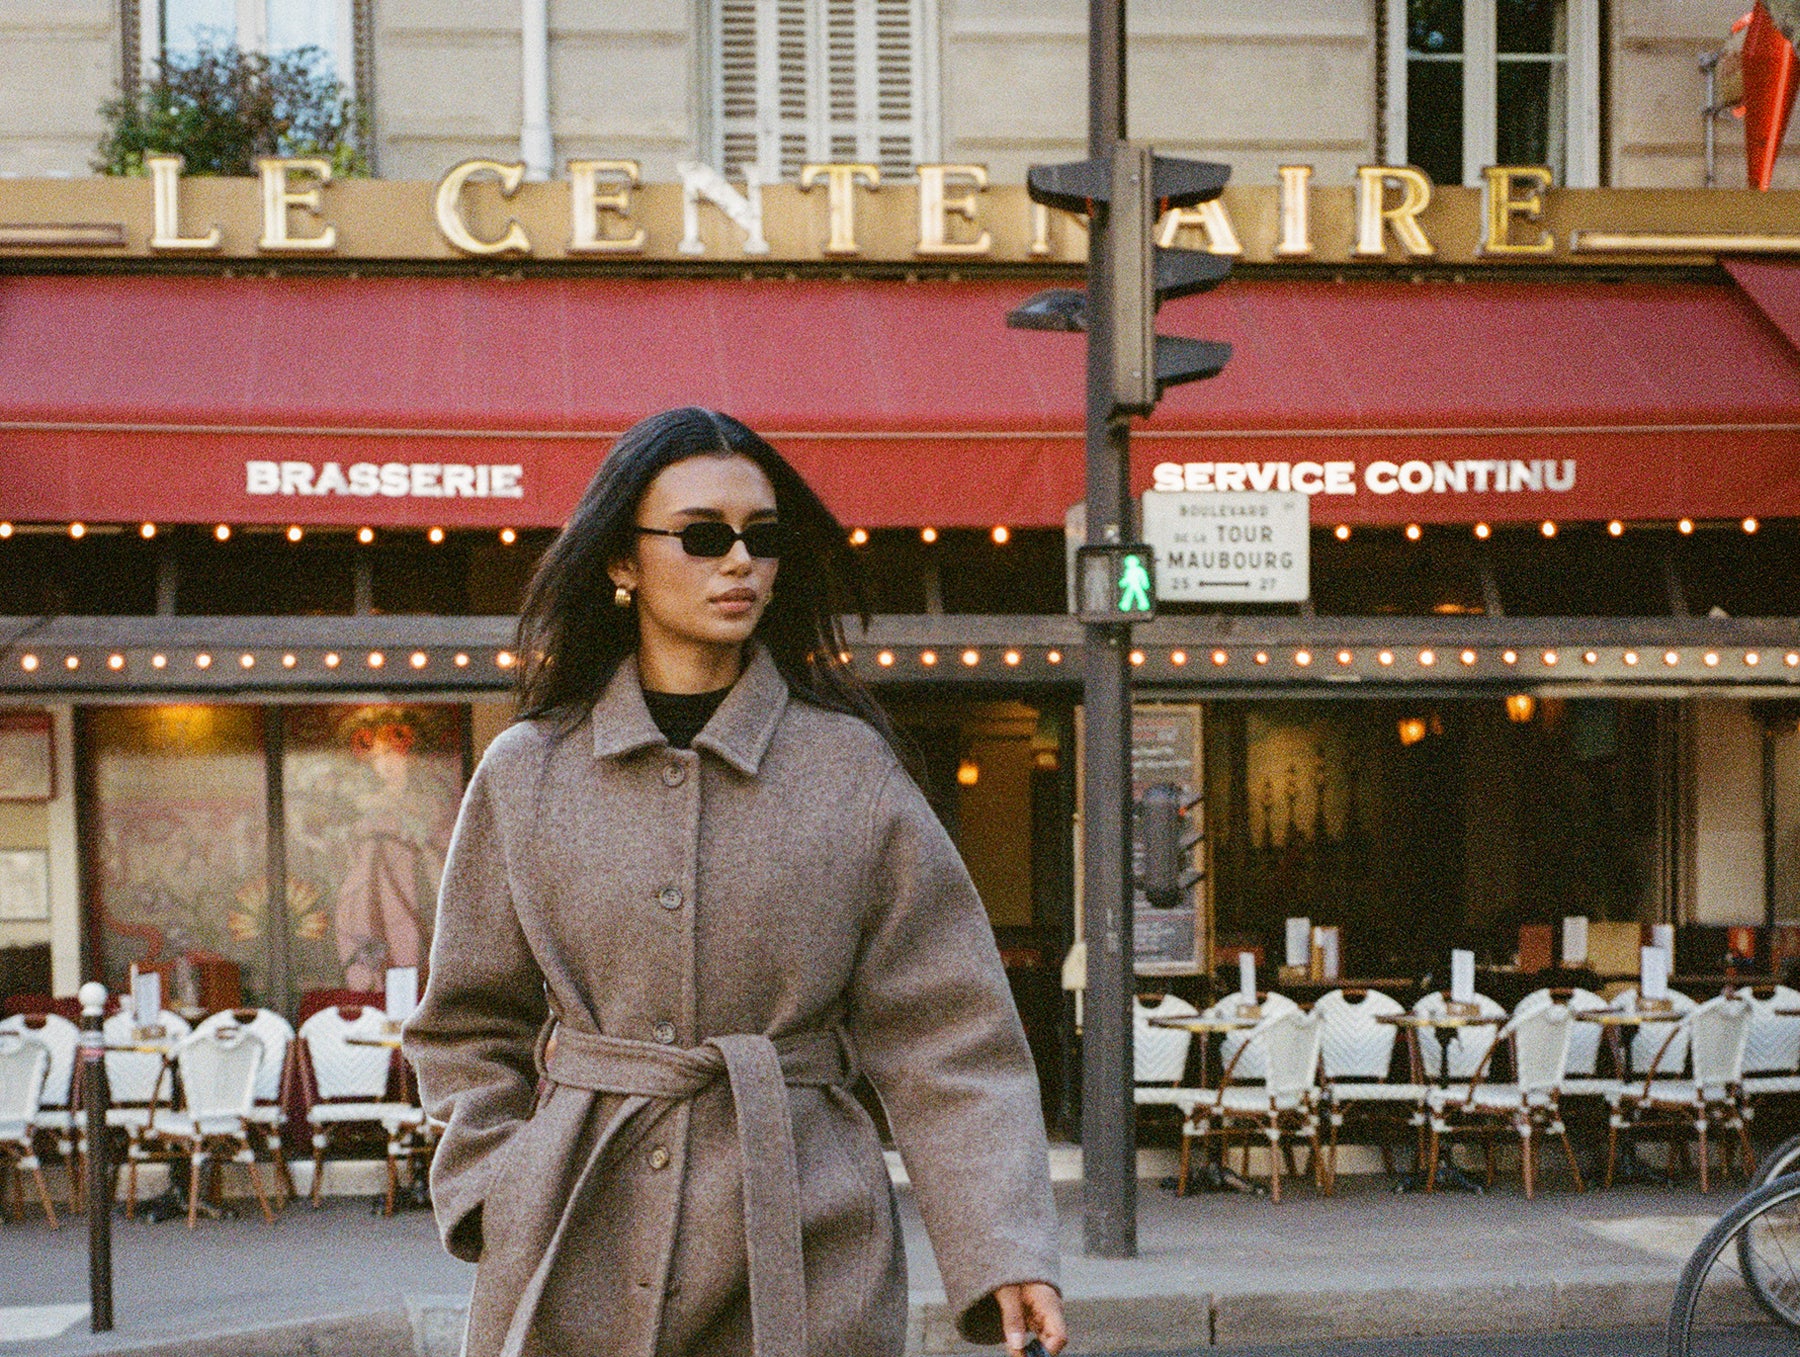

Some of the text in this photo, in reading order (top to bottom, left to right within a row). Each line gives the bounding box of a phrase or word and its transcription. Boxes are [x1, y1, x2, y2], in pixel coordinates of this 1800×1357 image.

[146, 156, 338, 252] LE
[246, 460, 524, 498] BRASSERIE
[1153, 459, 1577, 495] SERVICE CONTINU
[1179, 504, 1268, 517] BOULEVARD
[1216, 525, 1273, 543] TOUR
[1168, 551, 1294, 569] MAUBOURG
